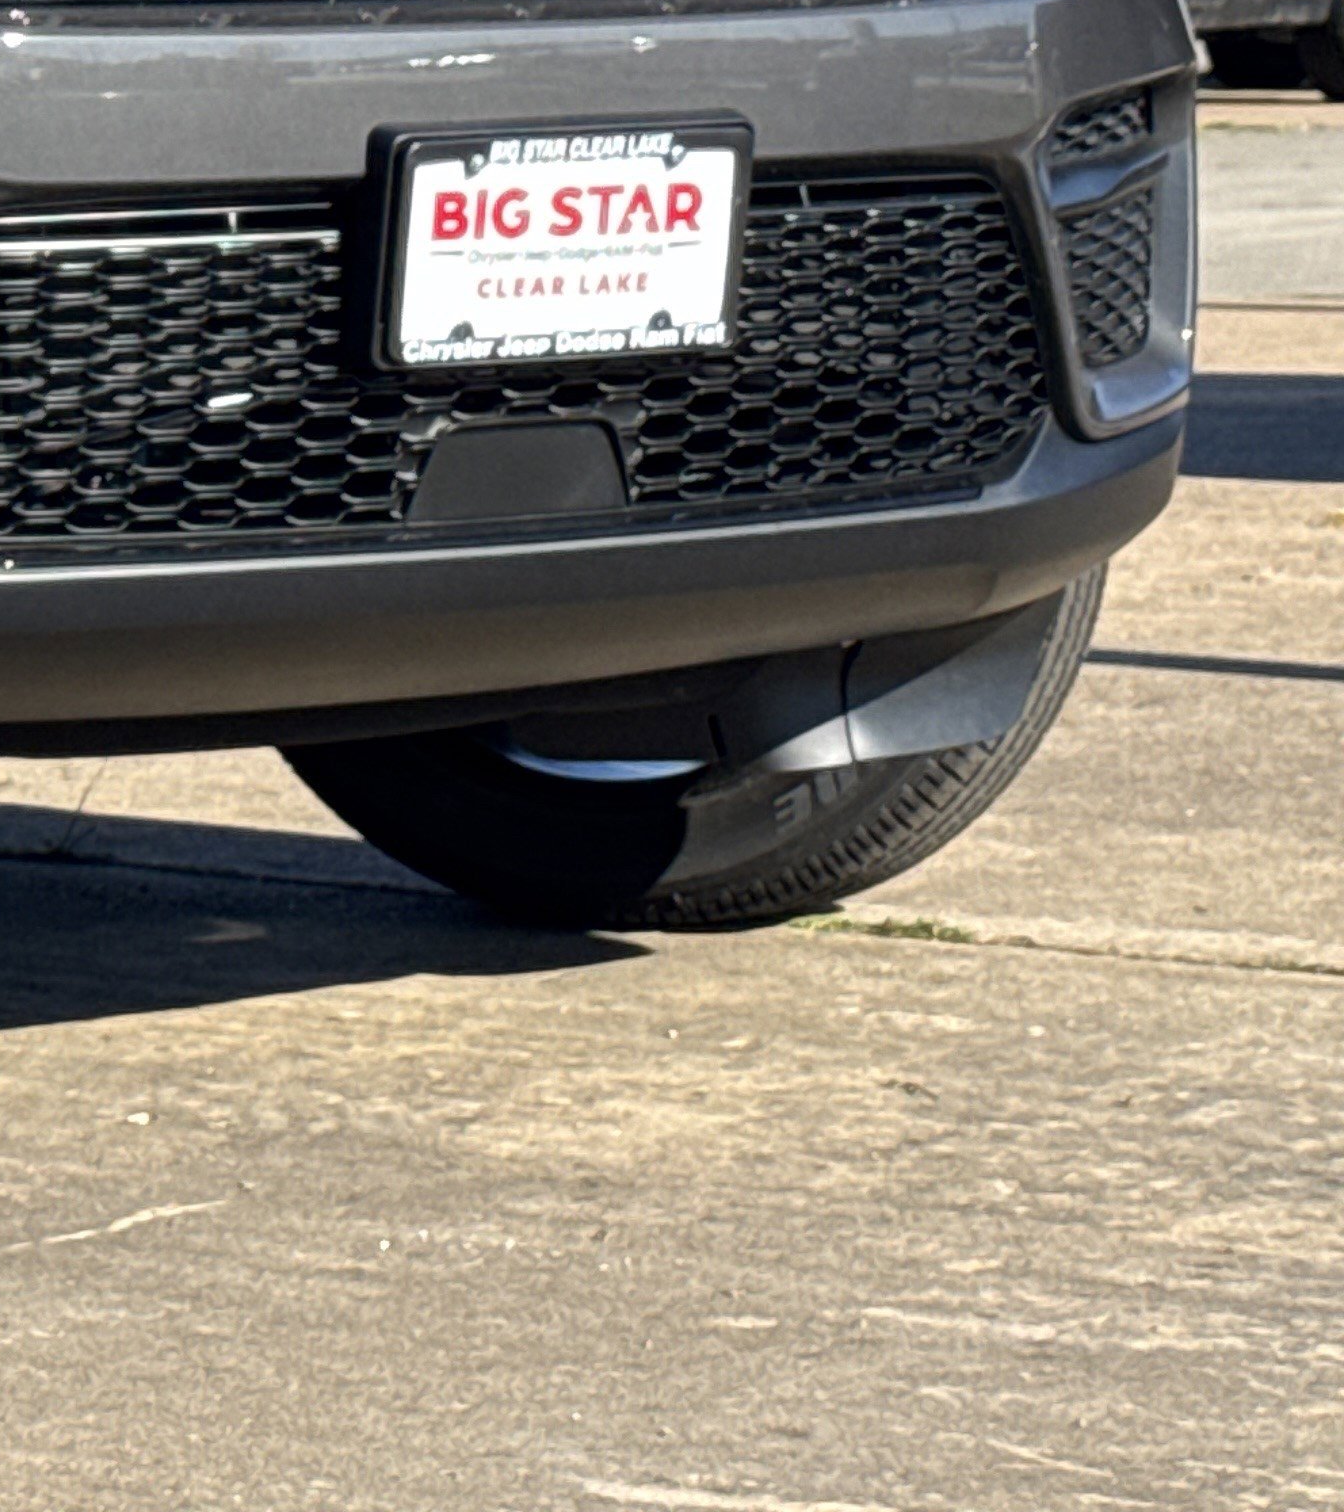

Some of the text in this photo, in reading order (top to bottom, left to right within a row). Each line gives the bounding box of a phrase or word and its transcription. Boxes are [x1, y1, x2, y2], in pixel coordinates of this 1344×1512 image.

[569, 135, 627, 161] CLEAR
[431, 183, 703, 241] BIG STAR
[476, 272, 650, 299] CLEAR LAKE
